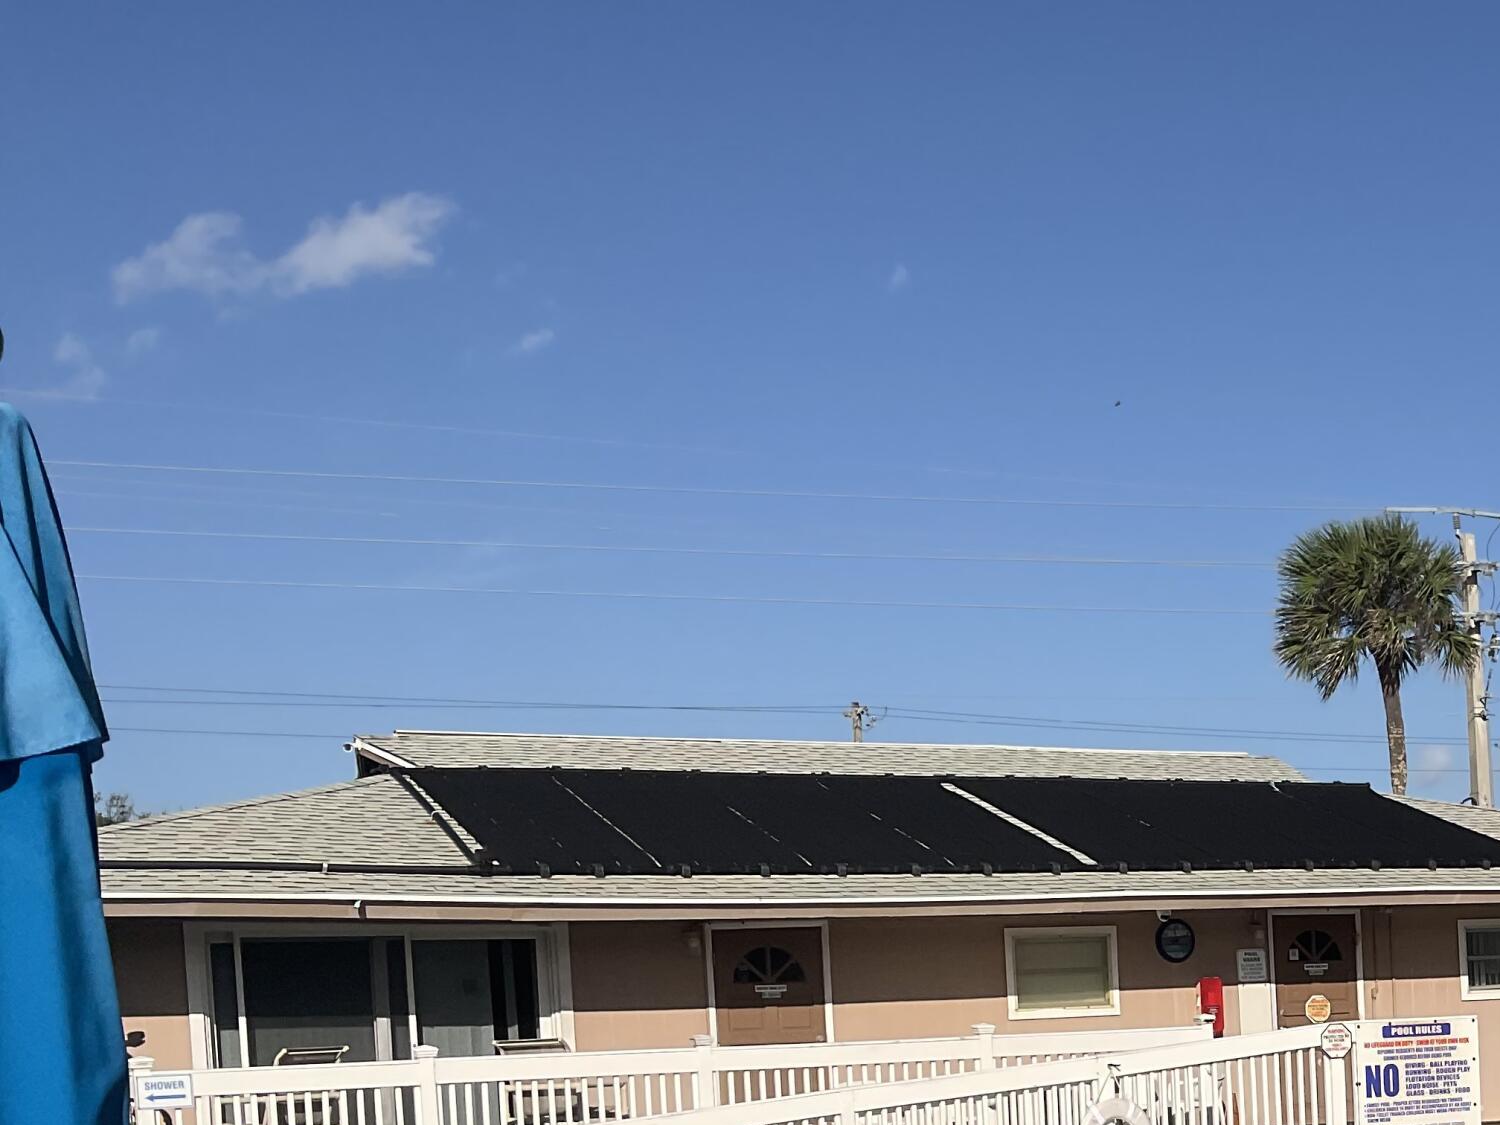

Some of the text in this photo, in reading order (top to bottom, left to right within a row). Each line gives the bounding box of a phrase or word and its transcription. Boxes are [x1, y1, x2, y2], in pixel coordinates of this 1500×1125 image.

[1391, 1025, 1442, 1036] POOL RULES
[144, 1080, 185, 1090] SHOWER
[1365, 1063, 1400, 1098] NO
